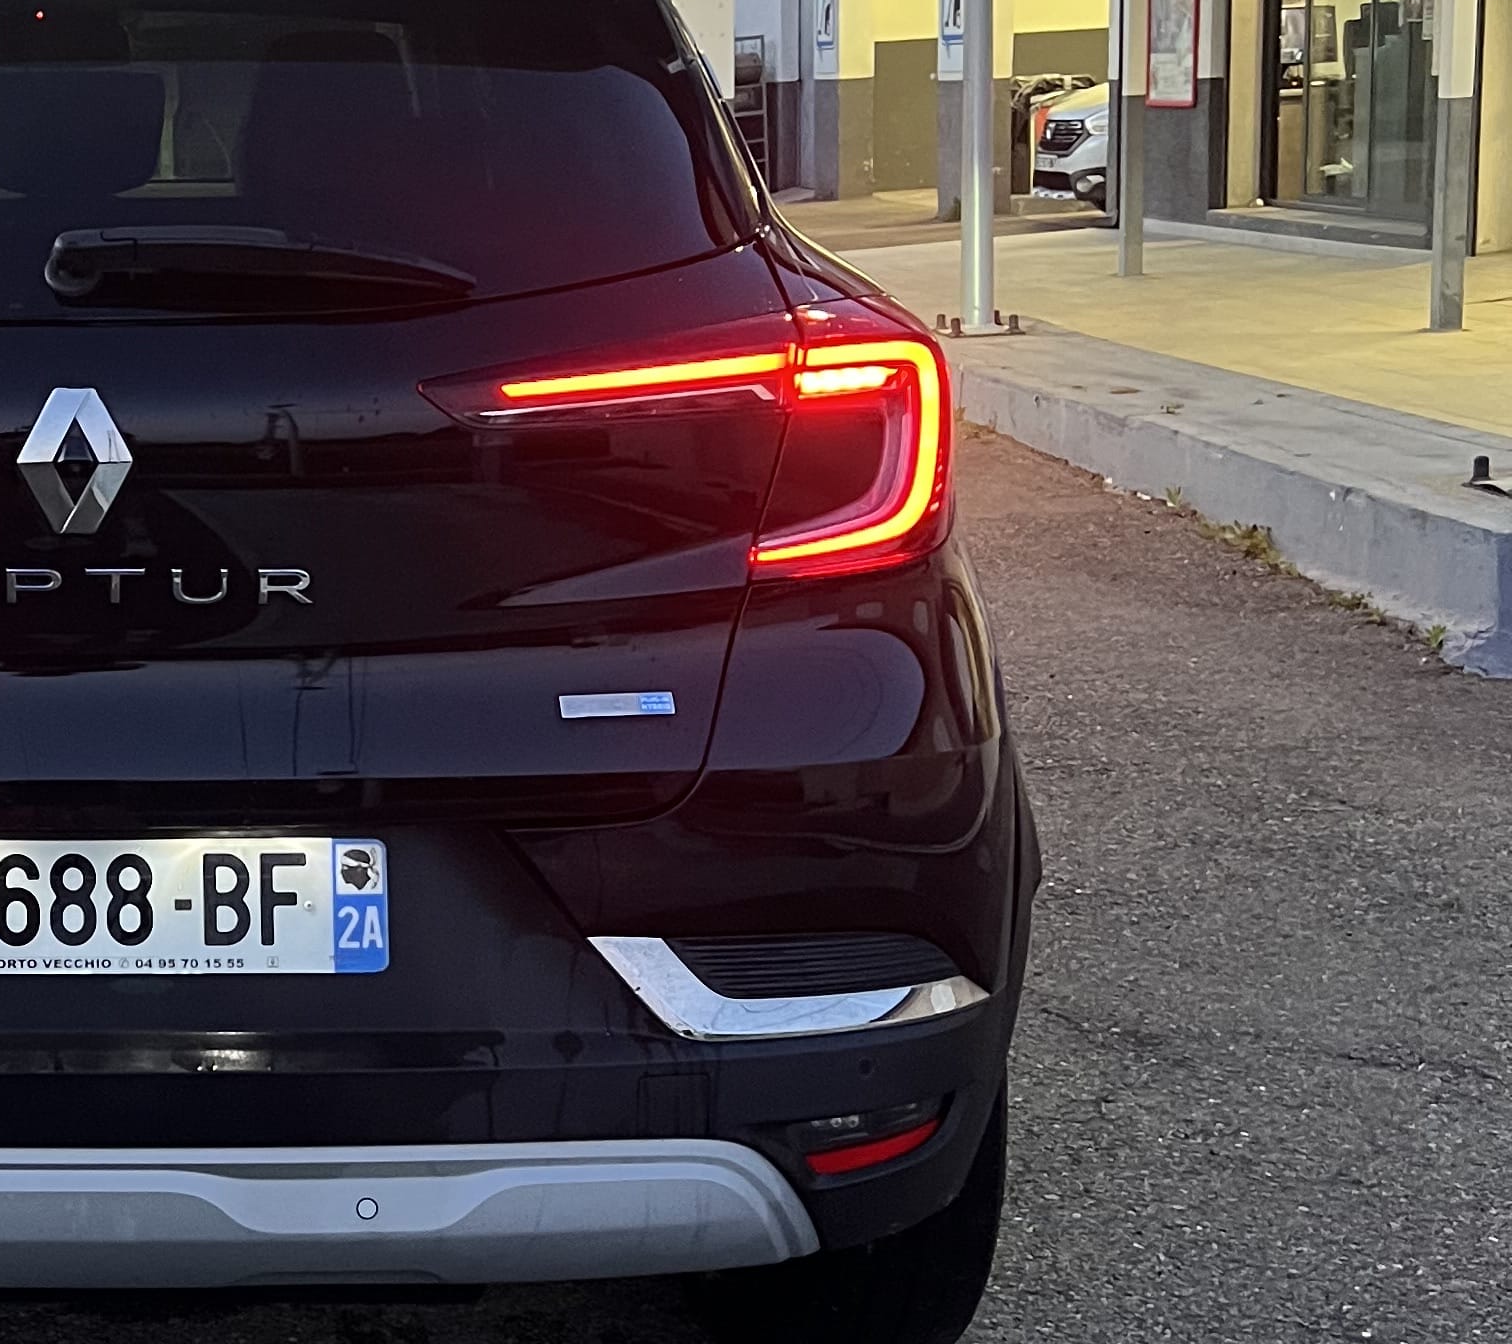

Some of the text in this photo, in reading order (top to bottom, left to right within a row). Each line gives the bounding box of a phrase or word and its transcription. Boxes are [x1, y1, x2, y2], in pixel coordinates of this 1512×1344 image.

[337, 905, 384, 949] 2A
[42, 959, 112, 969] VECCHIO
[135, 958, 153, 969] 04
[181, 958, 199, 969] 70
